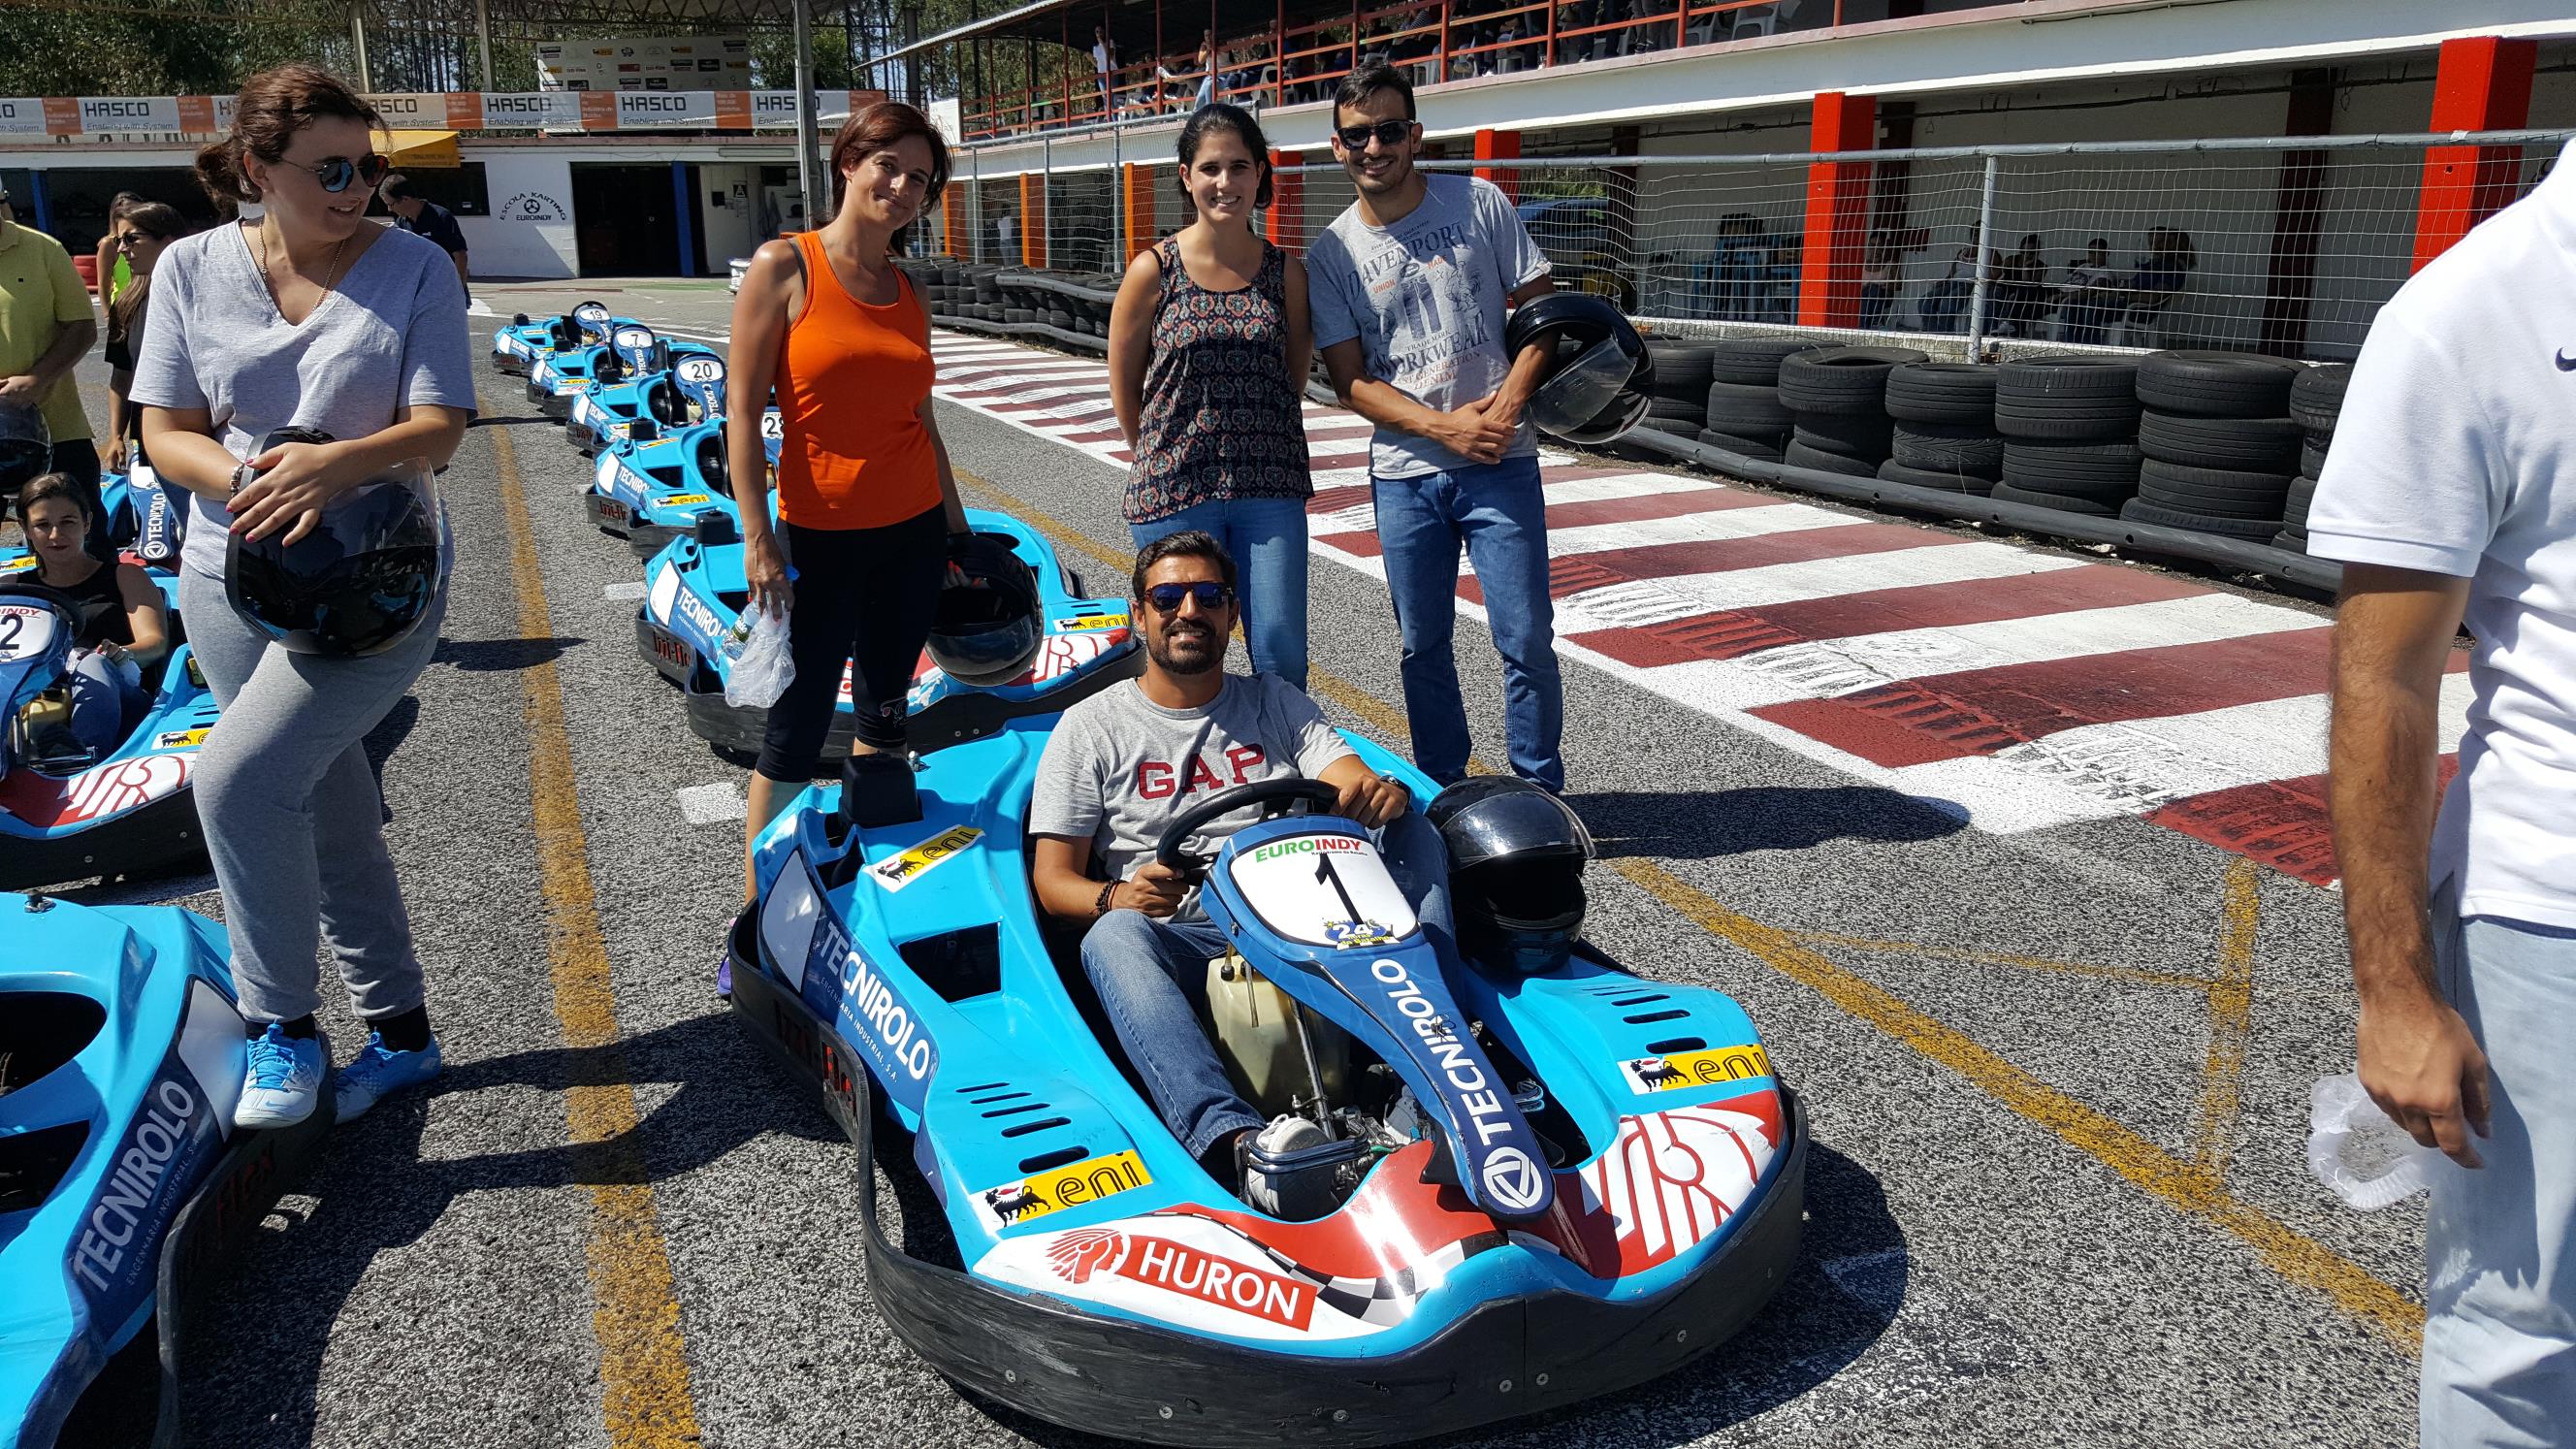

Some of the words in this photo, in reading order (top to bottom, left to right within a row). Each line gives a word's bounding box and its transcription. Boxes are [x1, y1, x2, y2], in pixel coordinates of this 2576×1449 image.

[84, 102, 150, 116] HASCO
[370, 98, 418, 113] ASCO
[487, 98, 552, 113] HASCO
[622, 96, 687, 112] HASCO
[488, 117, 525, 126] Enabling
[623, 116, 659, 126] Enabling
[499, 193, 527, 221] ESCOLA
[531, 192, 567, 221] KARTING
[1347, 222, 1471, 301] DAVENPORT
[1372, 278, 1396, 293] UNION
[589, 309, 603, 320] 19
[630, 334, 639, 346] 7
[1373, 310, 1491, 377] WORKWEAR
[692, 363, 713, 379] 20
[1416, 350, 1481, 380] GENERATION
[0, 614, 23, 650] 2
[1090, 614, 1128, 628] eni
[1138, 743, 1266, 800] GAP
[922, 829, 978, 860] eni
[1255, 838, 1362, 863] EUROINDY
[1314, 853, 1365, 924] 1
[1332, 924, 1373, 939] 24
[820, 922, 930, 1080] TECNIROLO
[821, 977, 853, 1022] ENGENHARIA
[1371, 958, 1512, 1146] TECNIROLO
[1692, 1044, 1770, 1084] eni
[72, 1079, 195, 1295] TECNIROLO
[1055, 1151, 1142, 1208] eni
[1138, 1240, 1301, 1321] HURON
